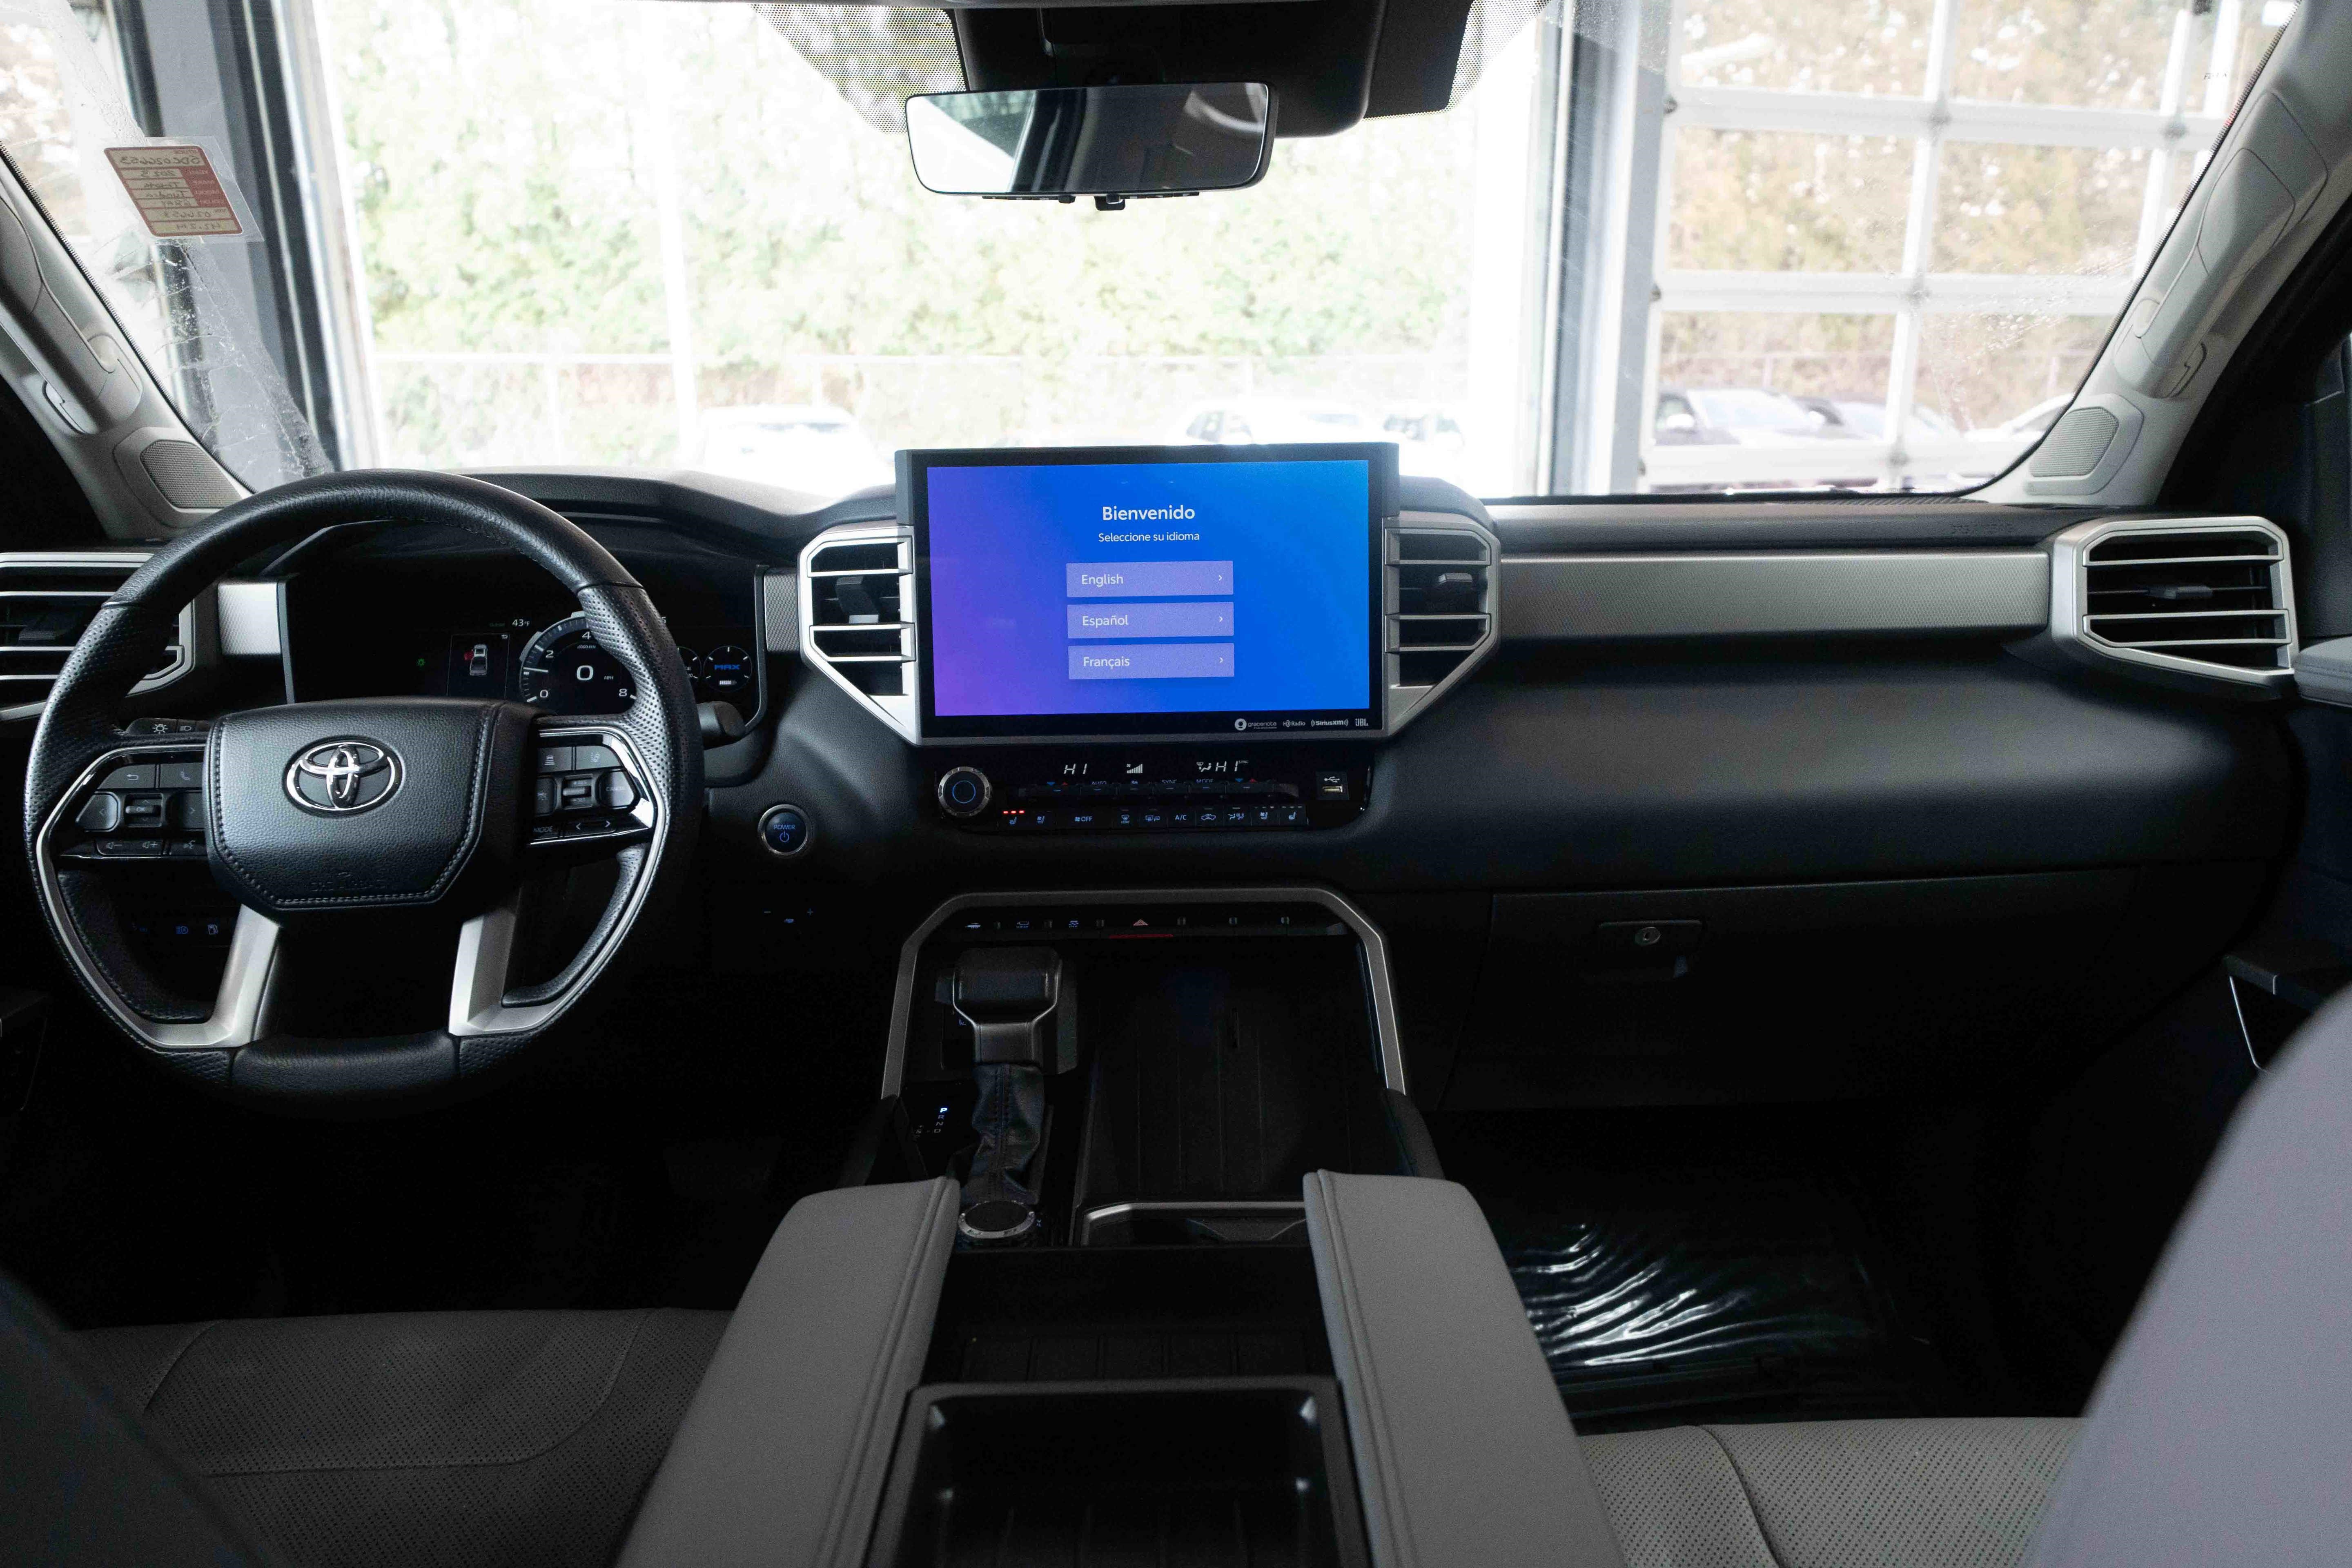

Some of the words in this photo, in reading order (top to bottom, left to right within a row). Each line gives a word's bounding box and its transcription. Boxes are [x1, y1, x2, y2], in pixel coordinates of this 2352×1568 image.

[1102, 504, 1196, 521] Bienvenido
[1098, 532, 1151, 542] Seleccione
[1166, 531, 1200, 541] idioma
[1081, 573, 1124, 588] English
[1082, 614, 1129, 629] Español
[581, 631, 591, 639] 4
[545, 650, 554, 658] 2
[1083, 655, 1130, 670] Français
[576, 665, 594, 681] 0
[539, 689, 549, 698] 0
[618, 688, 628, 697] 8
[1355, 718, 1369, 726] JBL
